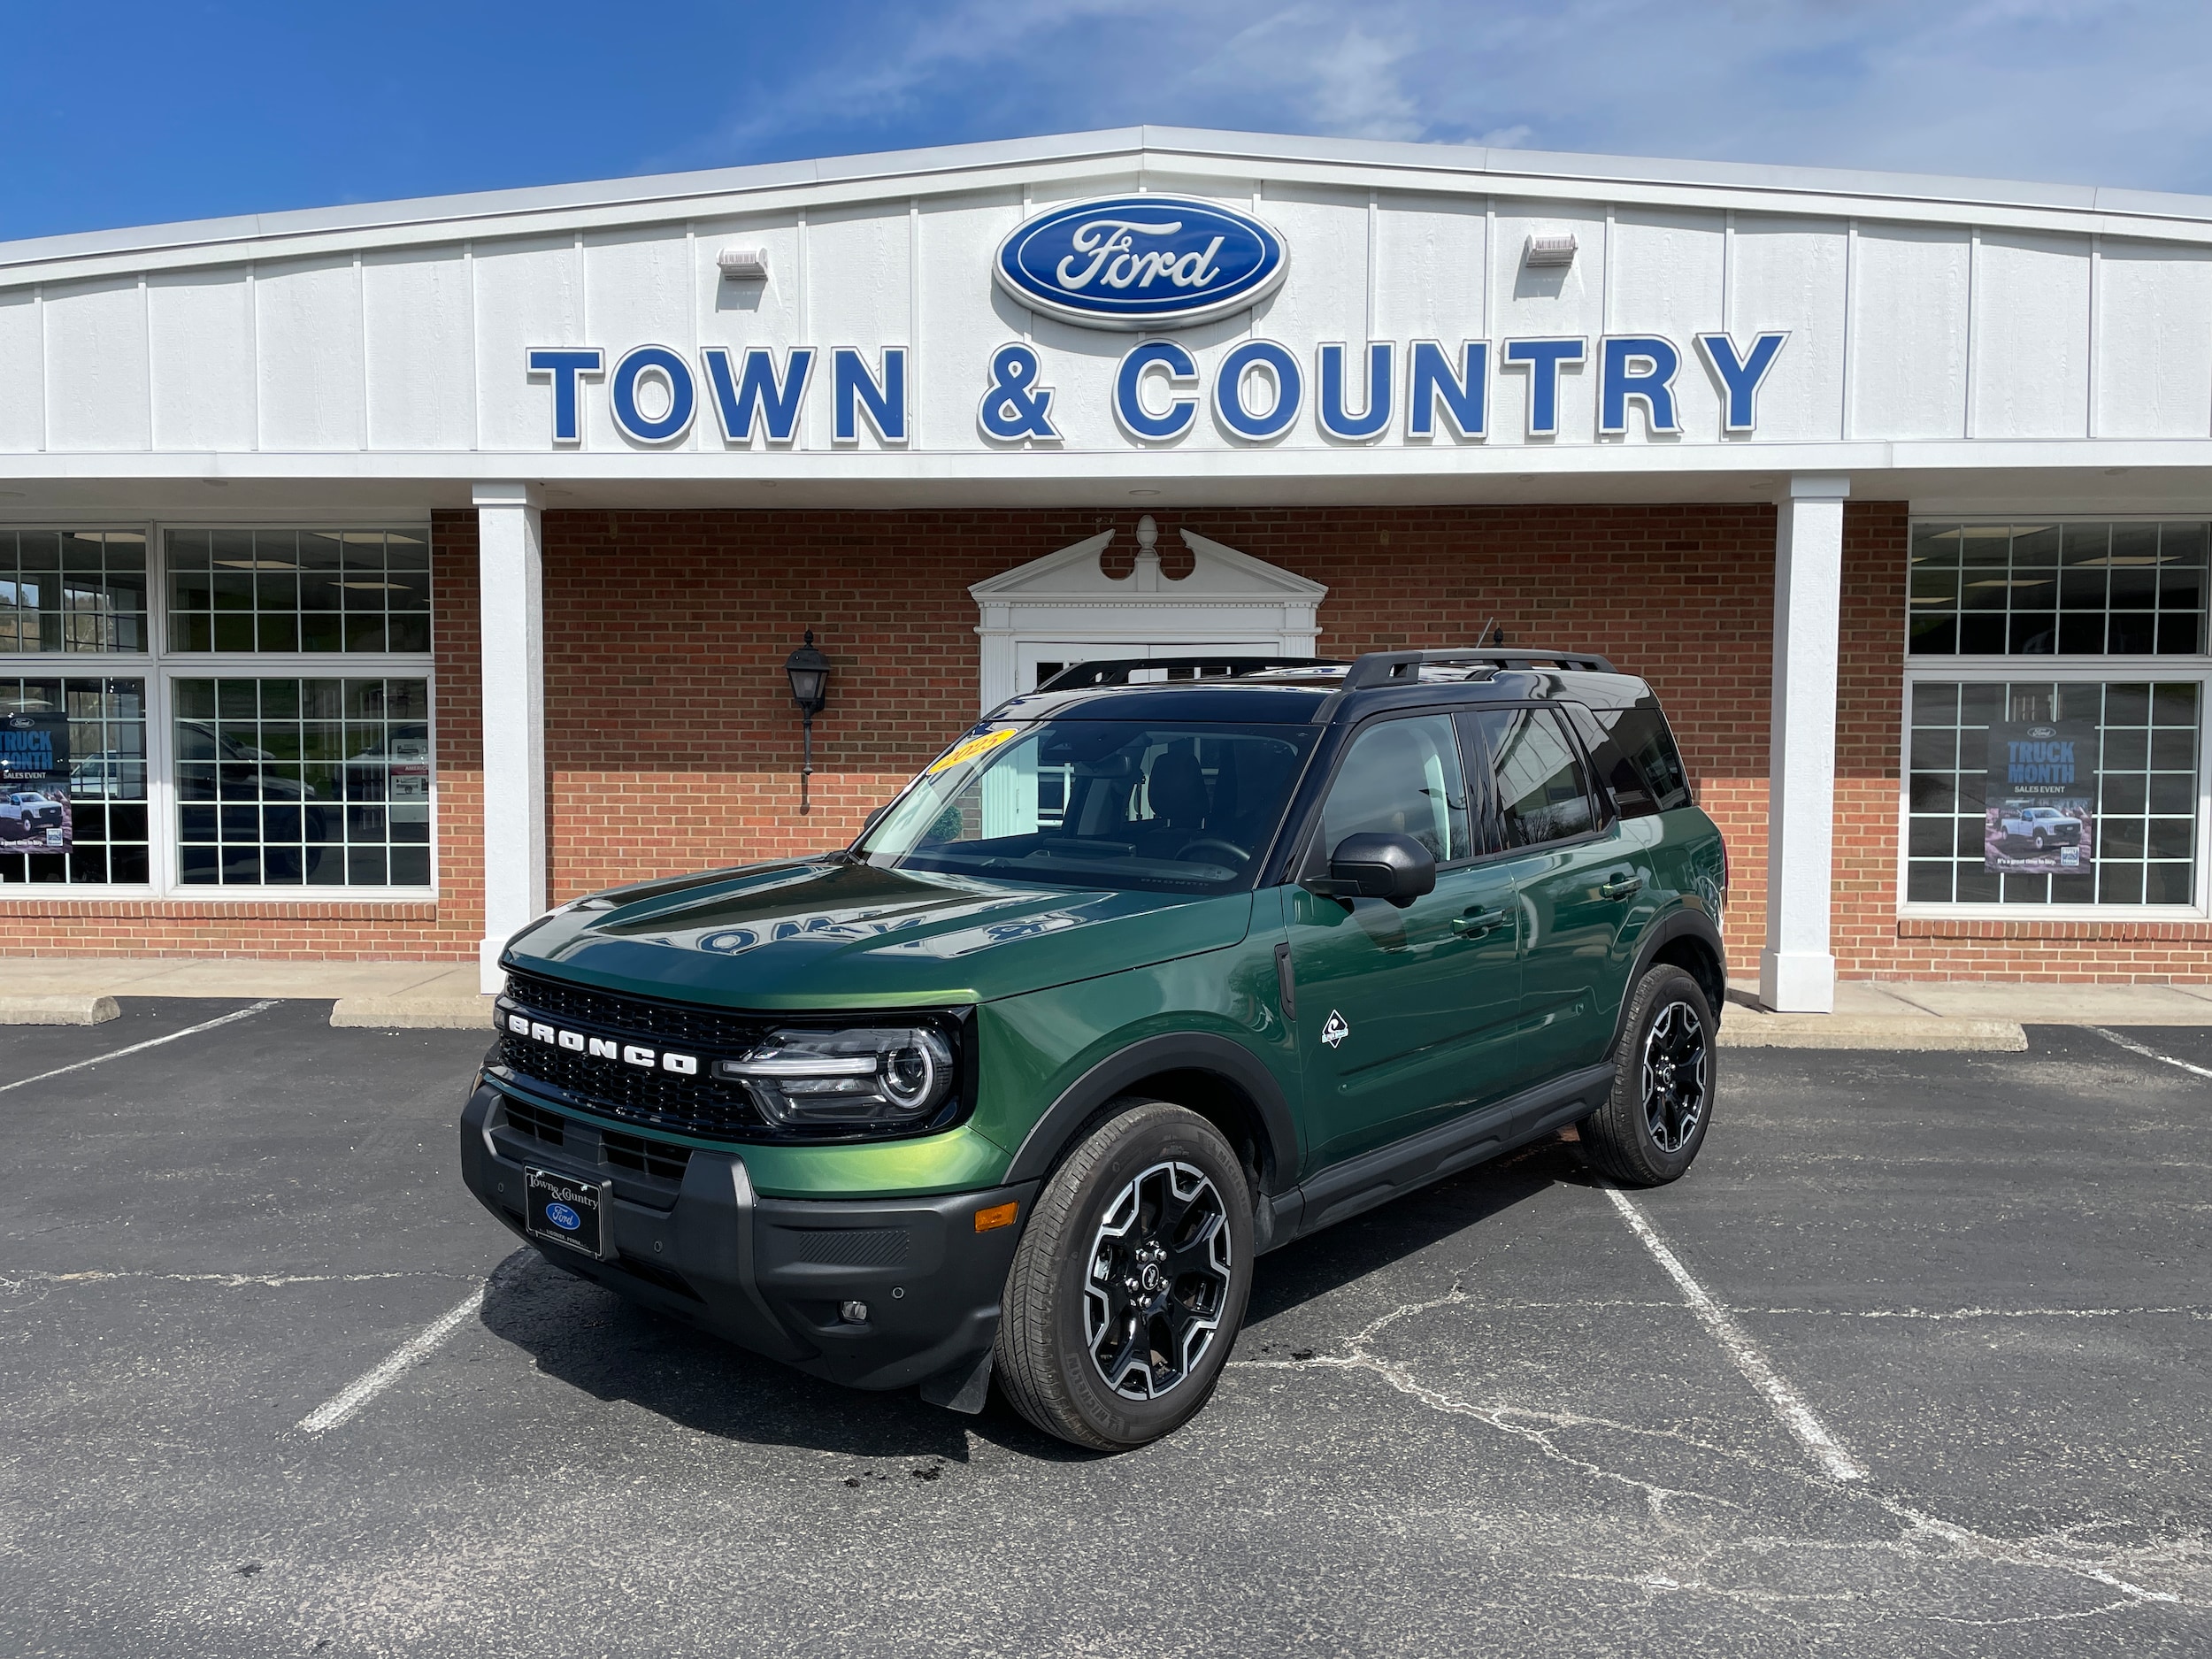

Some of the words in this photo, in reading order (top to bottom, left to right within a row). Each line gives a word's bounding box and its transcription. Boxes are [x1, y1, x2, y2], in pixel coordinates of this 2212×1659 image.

[1056, 220, 1225, 289] Ford
[526, 343, 910, 443] TOWN
[977, 341, 1064, 442] &
[1112, 331, 1793, 442] COUNTRY
[938, 731, 1007, 770] 2025
[2008, 741, 2075, 764] TRUCK
[2008, 764, 2075, 783] MONTH
[2014, 785, 2039, 794] SALES
[508, 1014, 697, 1075] BRONCO
[552, 1205, 574, 1226] Ford
